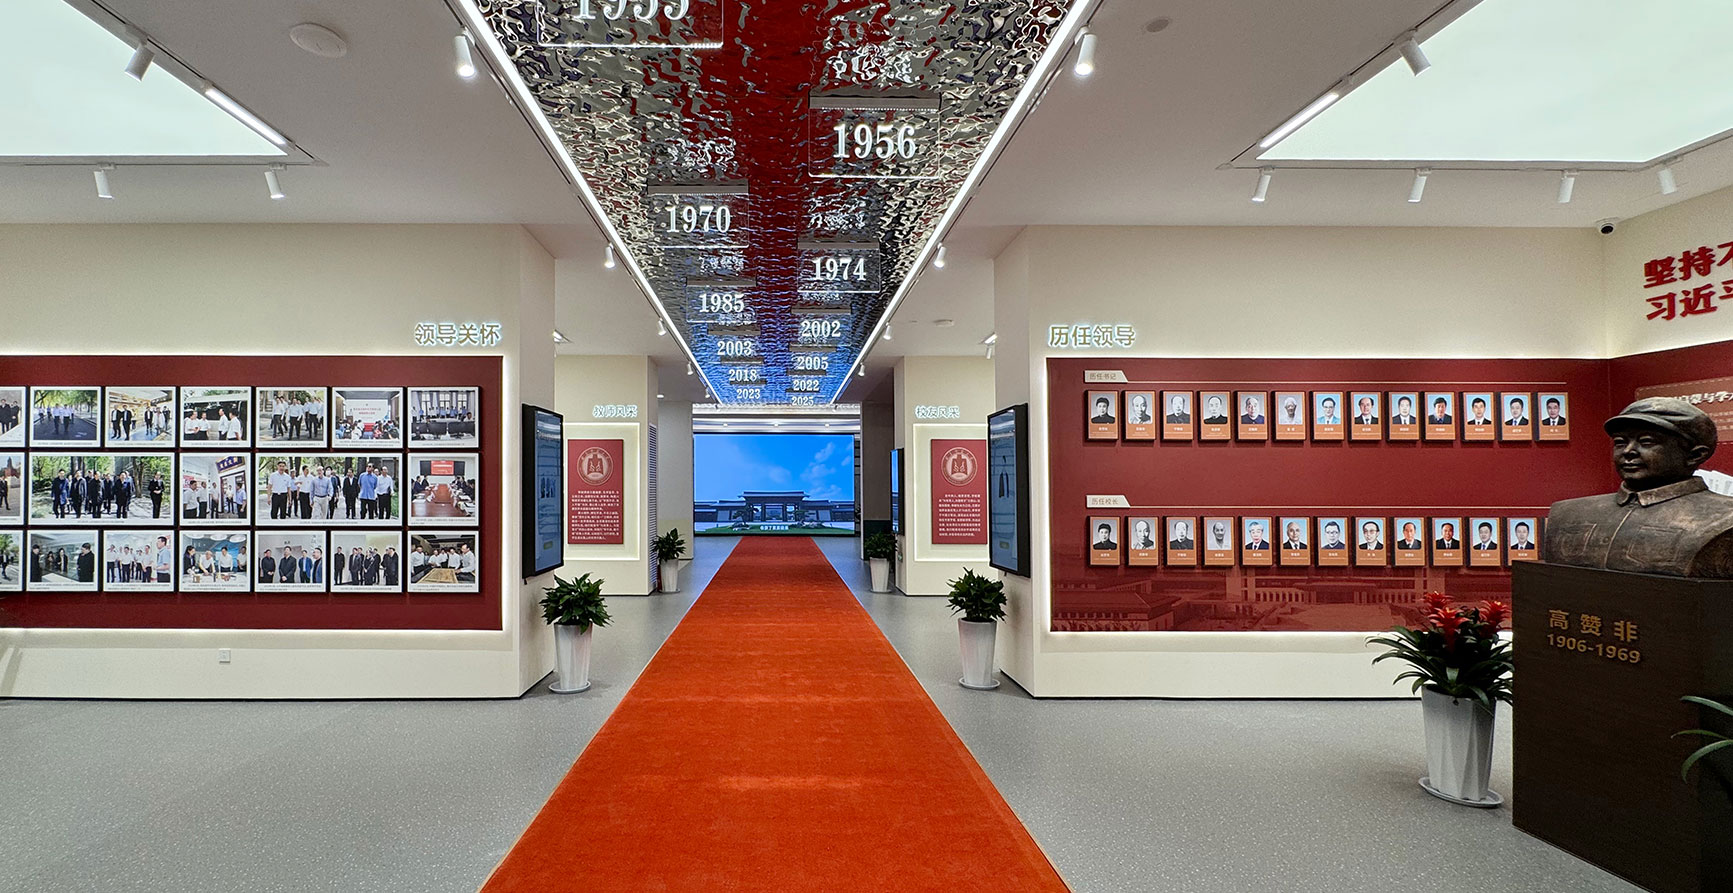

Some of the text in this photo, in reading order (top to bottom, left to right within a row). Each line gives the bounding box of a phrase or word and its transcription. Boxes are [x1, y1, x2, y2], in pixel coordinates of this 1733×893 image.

[832, 124, 917, 160] 1956
[665, 206, 732, 233] 1970
[812, 258, 867, 281] 1974
[699, 293, 745, 313] 1985
[414, 322, 501, 347] 领导关怀
[801, 319, 841, 338] 2002
[1047, 324, 1137, 348] 历任领导
[717, 340, 752, 356] 2003
[797, 355, 829, 371] 2005
[728, 369, 757, 382] 2018
[793, 379, 820, 391] 2022
[736, 388, 761, 400] 2023
[592, 404, 639, 418] 教师风采
[915, 405, 961, 419] 校友风采
[1548, 609, 1639, 643] 高赞非
[1546, 633, 1641, 664] 1906-1969
